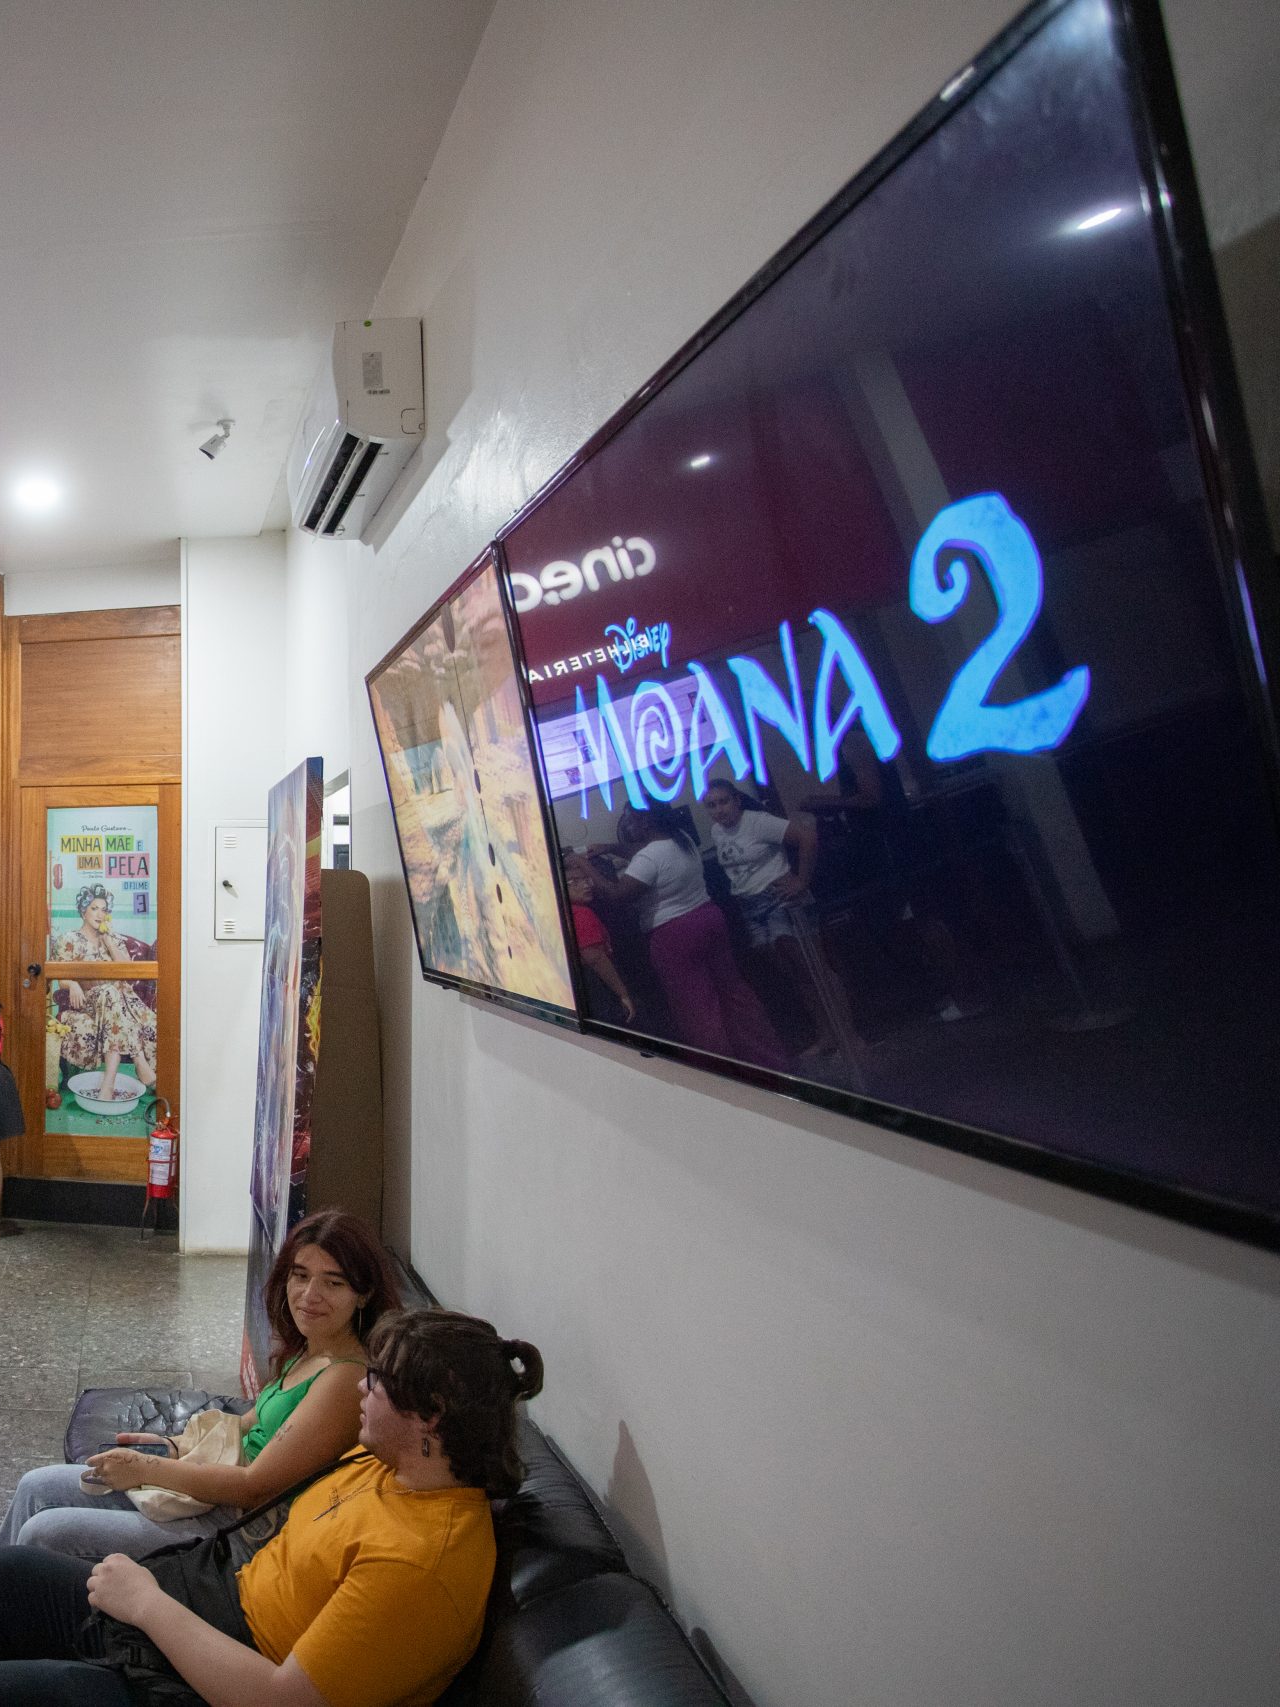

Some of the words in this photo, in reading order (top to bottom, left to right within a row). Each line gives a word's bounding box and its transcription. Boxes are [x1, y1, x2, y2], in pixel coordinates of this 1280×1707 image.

[574, 608, 901, 820] MOANA
[908, 491, 1092, 763] 2
[61, 837, 101, 852] MINHA
[106, 835, 131, 851] MÃE
[79, 856, 101, 869] UMA
[108, 856, 149, 878] PEÇA
[129, 881, 148, 890] FILME
[136, 894, 147, 913] 3
